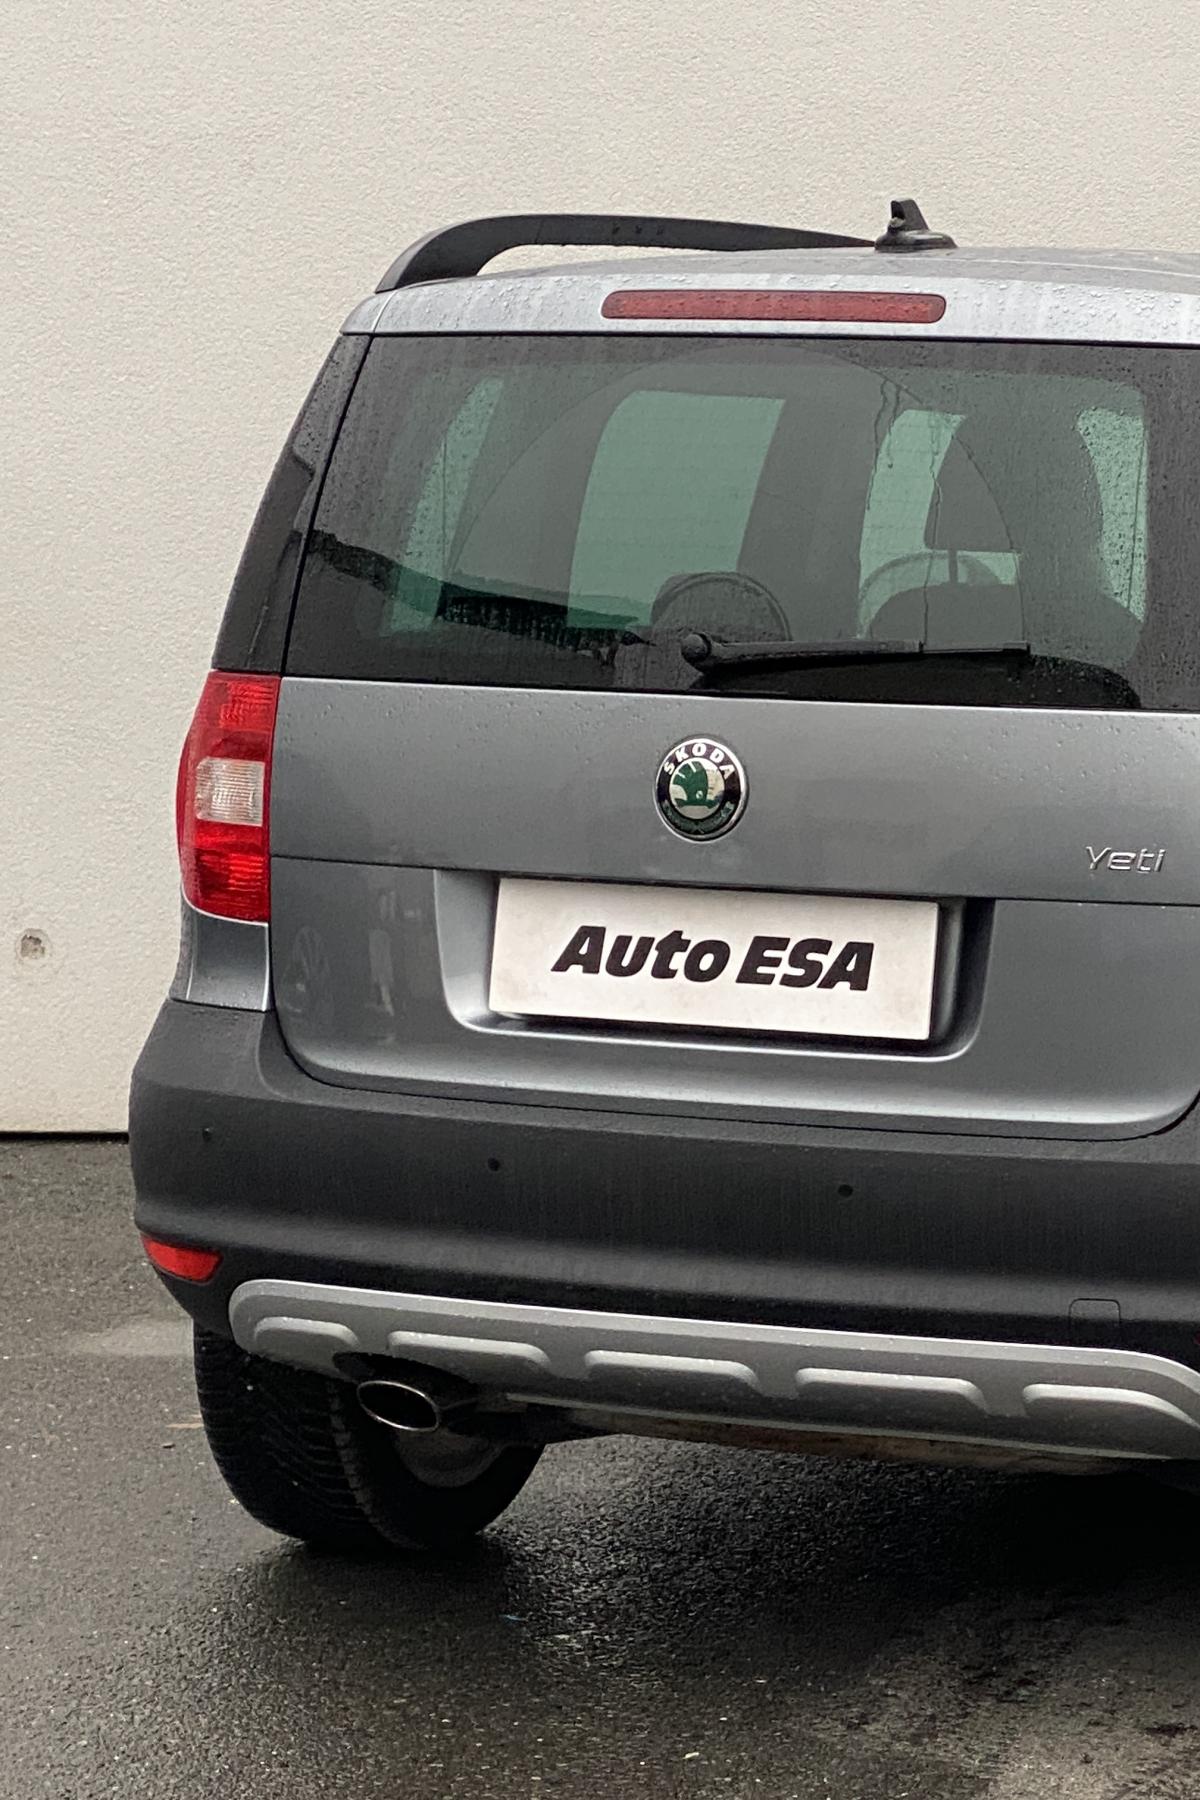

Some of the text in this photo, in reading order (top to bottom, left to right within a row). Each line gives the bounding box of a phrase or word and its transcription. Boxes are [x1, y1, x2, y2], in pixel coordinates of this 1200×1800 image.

[663, 742, 736, 780] SKODA
[1085, 846, 1166, 873] Yeti
[551, 925, 875, 992] Auto ESA
